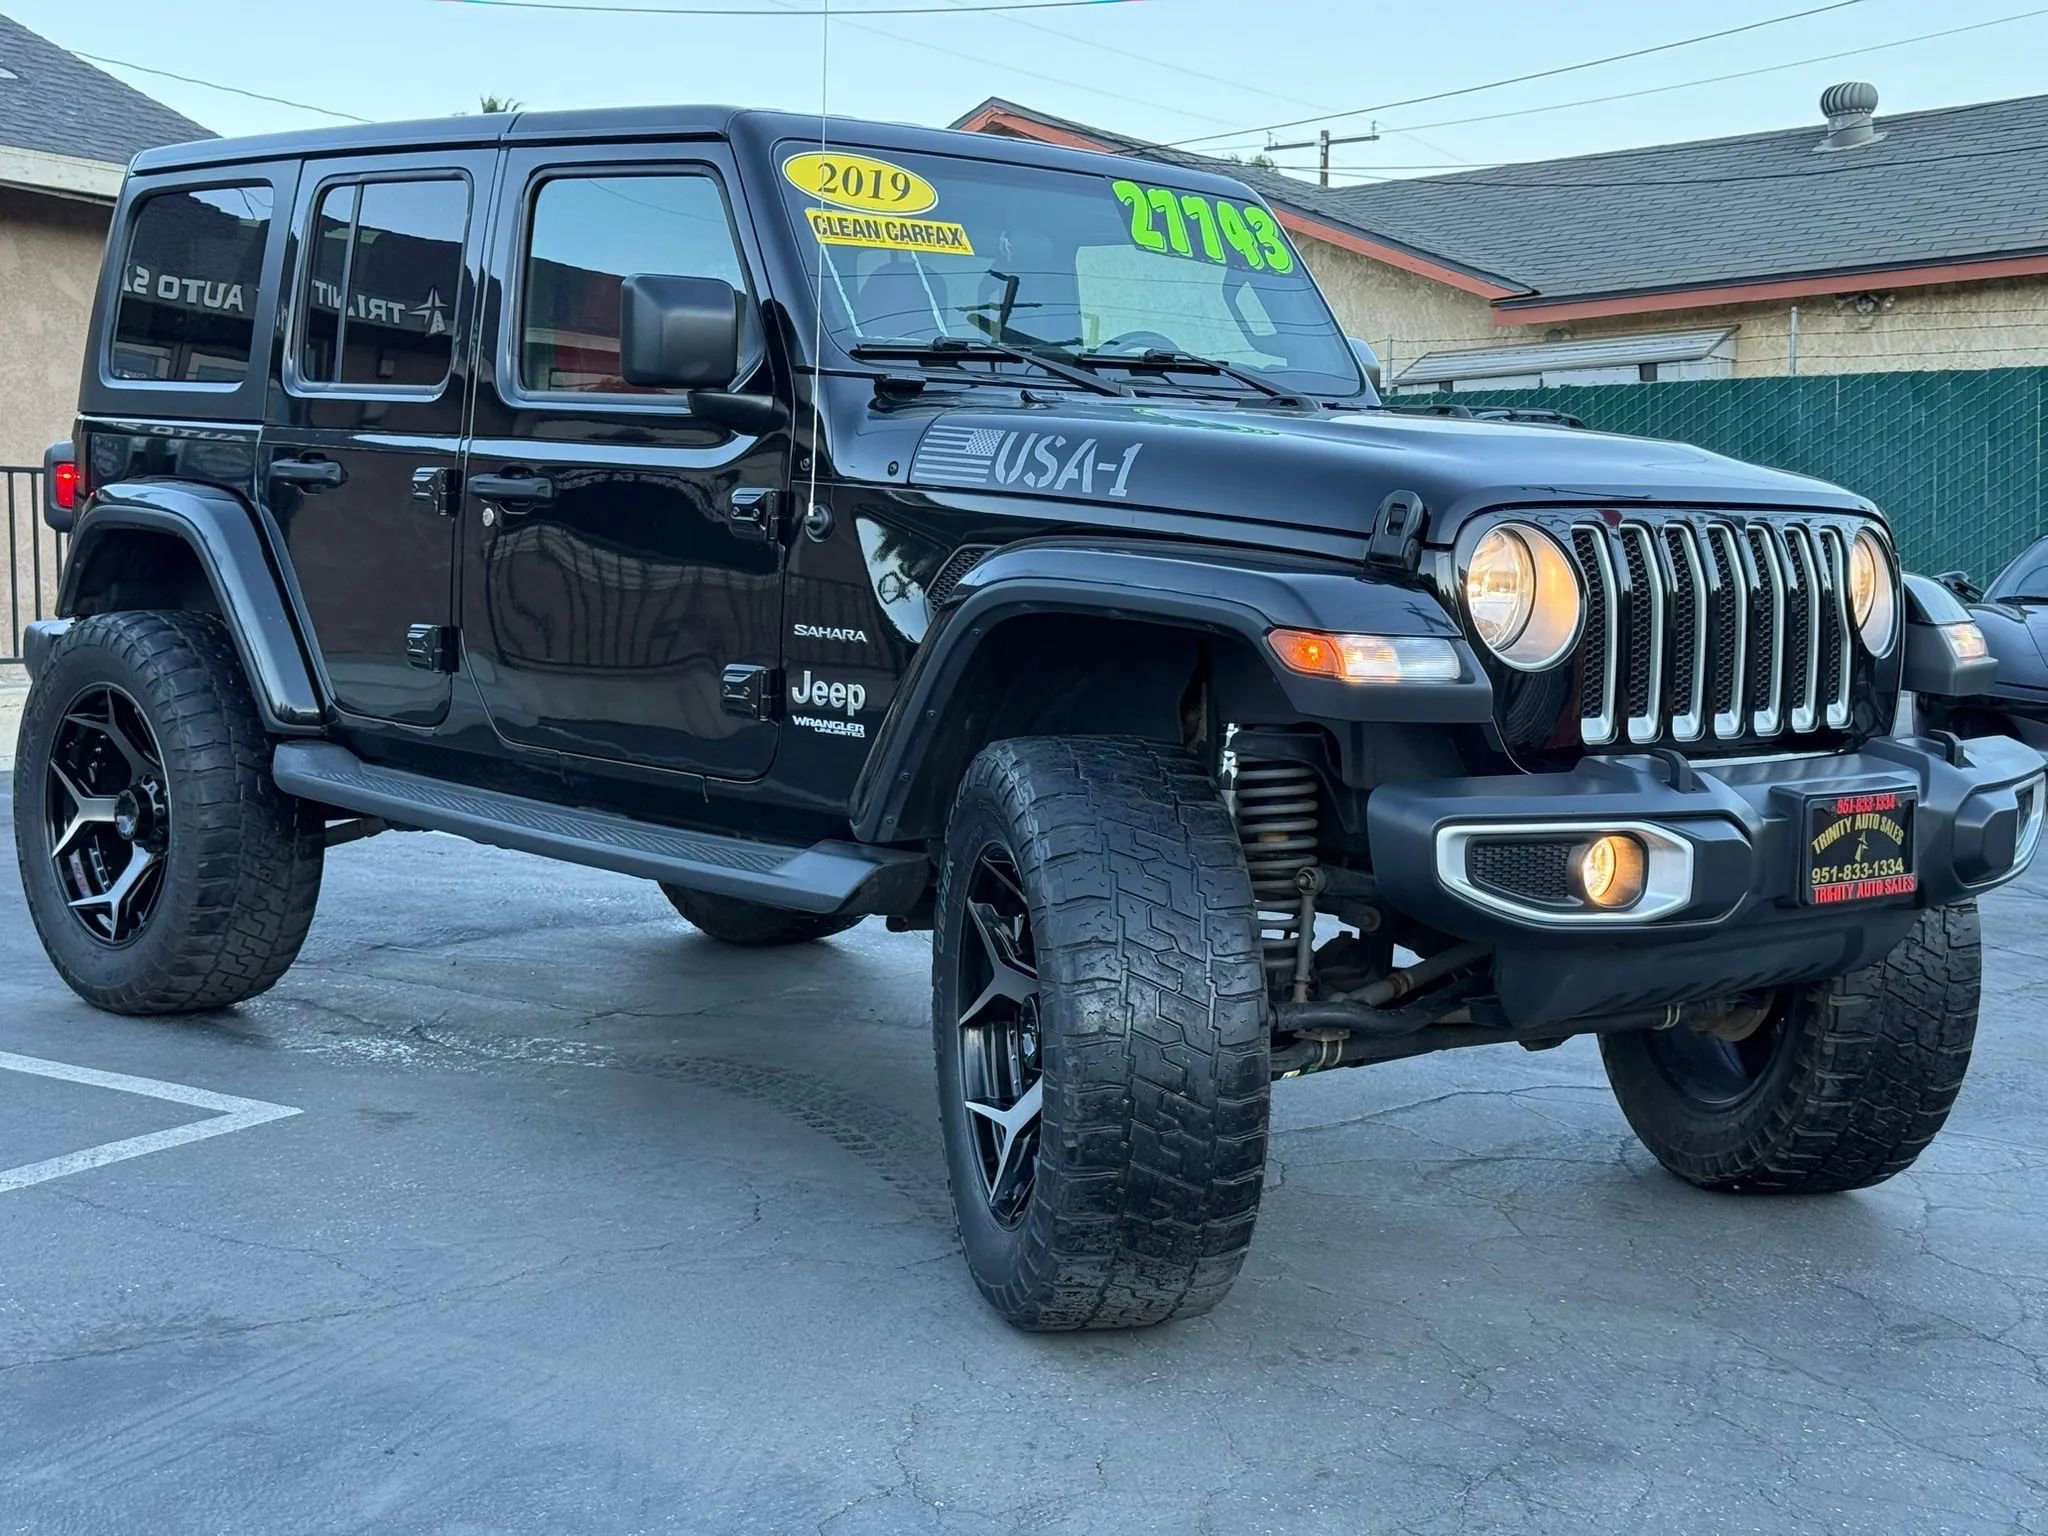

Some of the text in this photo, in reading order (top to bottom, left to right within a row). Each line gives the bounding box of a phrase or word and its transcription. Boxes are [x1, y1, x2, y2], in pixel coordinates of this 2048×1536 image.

[817, 162, 912, 202] 2019
[812, 214, 966, 250] CLEAN CARFAX
[1110, 178, 1294, 274] 27743
[994, 431, 1144, 497] USA-1
[793, 623, 868, 643] SAHARA
[791, 670, 866, 717] Jeep
[791, 715, 865, 733] WRANGLER
[814, 726, 866, 738] UNLIMITED
[1836, 794, 1896, 815] 951-833-1334
[1811, 813, 1905, 855] TRINITY AUTO SALES
[1811, 857, 1905, 885] 951-833-1334
[1813, 875, 1915, 904] TRINITY AUTO SALES
